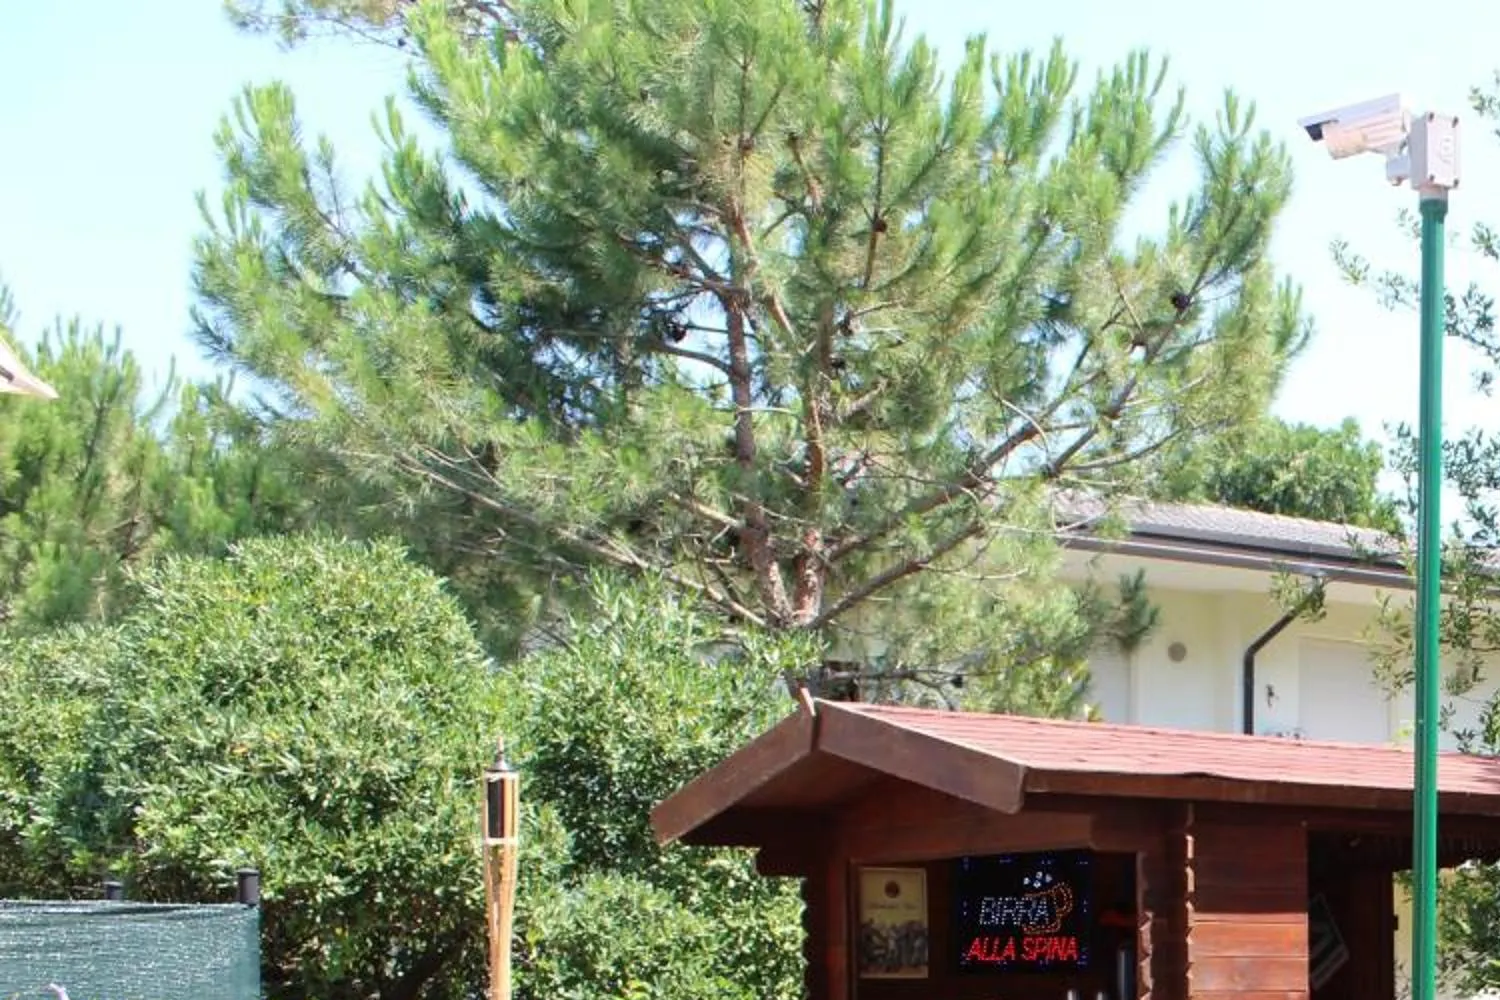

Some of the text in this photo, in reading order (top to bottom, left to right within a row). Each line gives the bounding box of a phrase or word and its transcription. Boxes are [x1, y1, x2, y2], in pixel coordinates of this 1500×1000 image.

[979, 897, 1049, 925] BIRRA
[966, 937, 1078, 961] ALLA SPINA
